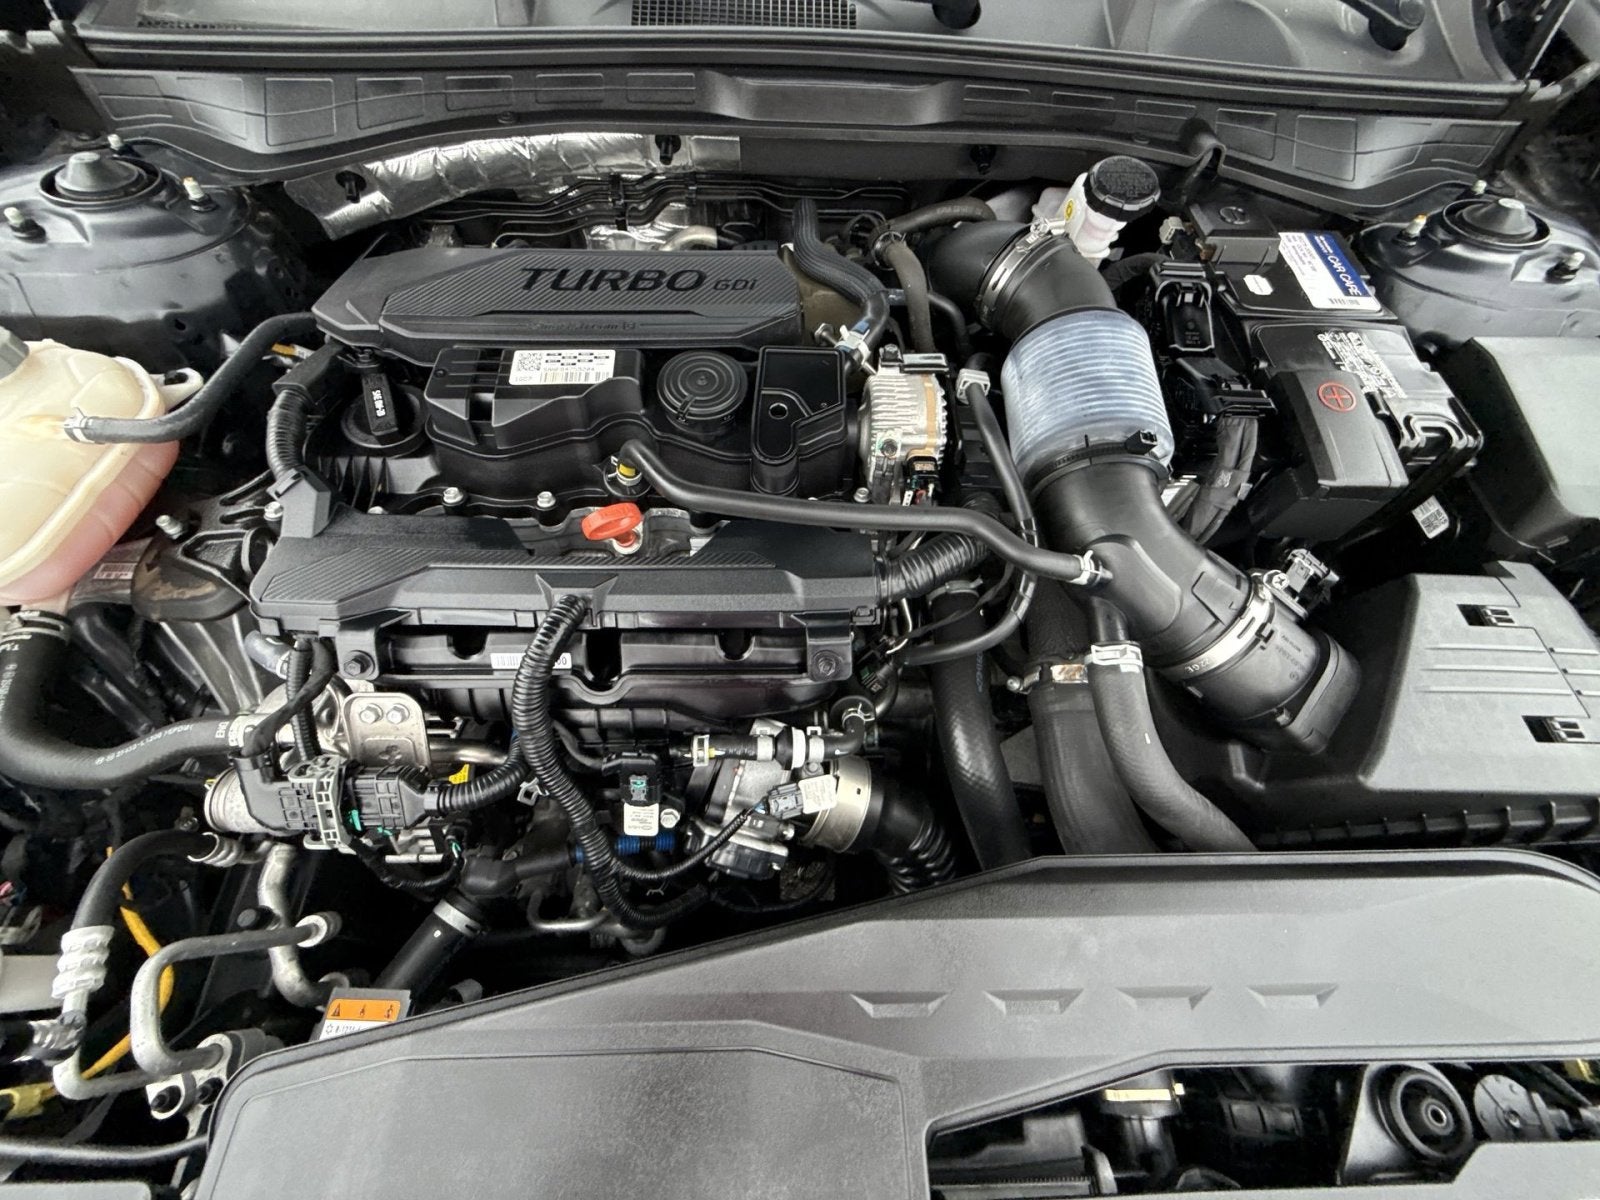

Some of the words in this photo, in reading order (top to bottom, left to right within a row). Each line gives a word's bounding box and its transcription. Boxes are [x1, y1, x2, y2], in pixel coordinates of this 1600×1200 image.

[521, 268, 707, 292] TURBO
[713, 278, 758, 291] GDi
[1328, 255, 1345, 273] CAR
[1340, 274, 1362, 296] CARE
